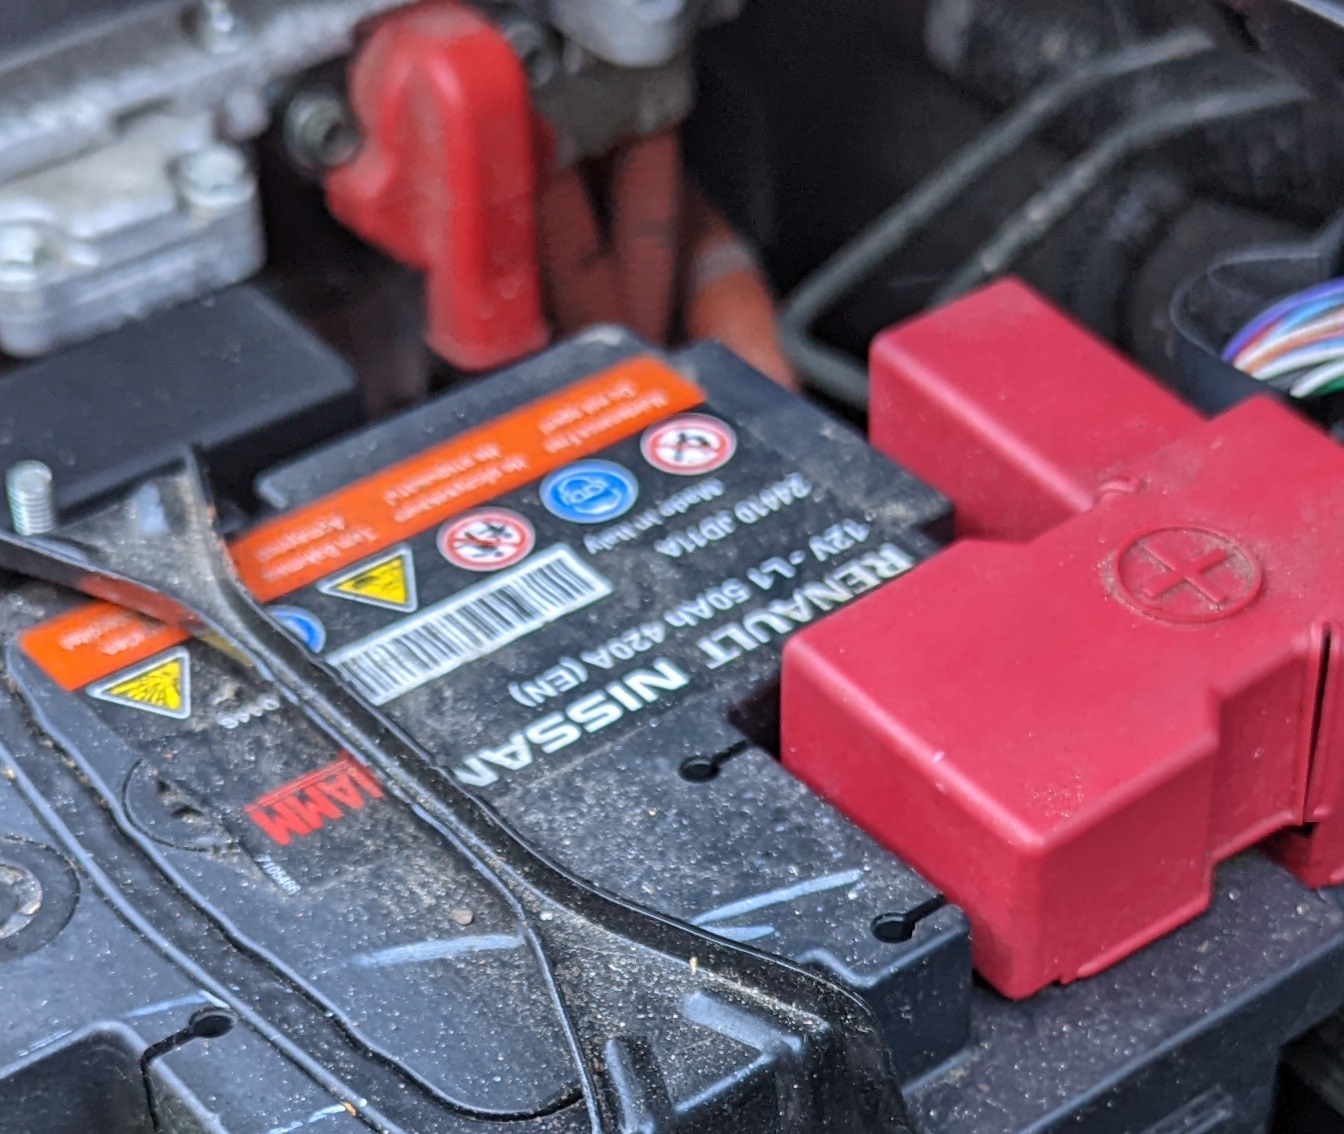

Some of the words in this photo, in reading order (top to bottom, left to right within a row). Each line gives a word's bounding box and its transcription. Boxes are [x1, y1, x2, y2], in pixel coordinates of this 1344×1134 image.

[809, 518, 870, 562] 12V
[746, 556, 797, 591] L1
[663, 577, 752, 627] 50Ah
[697, 542, 916, 670] RENAULT
[580, 619, 666, 670] 420A
[508, 655, 589, 708] (EN)
[453, 656, 691, 787] NISSAN
[246, 766, 385, 847] IAMM
